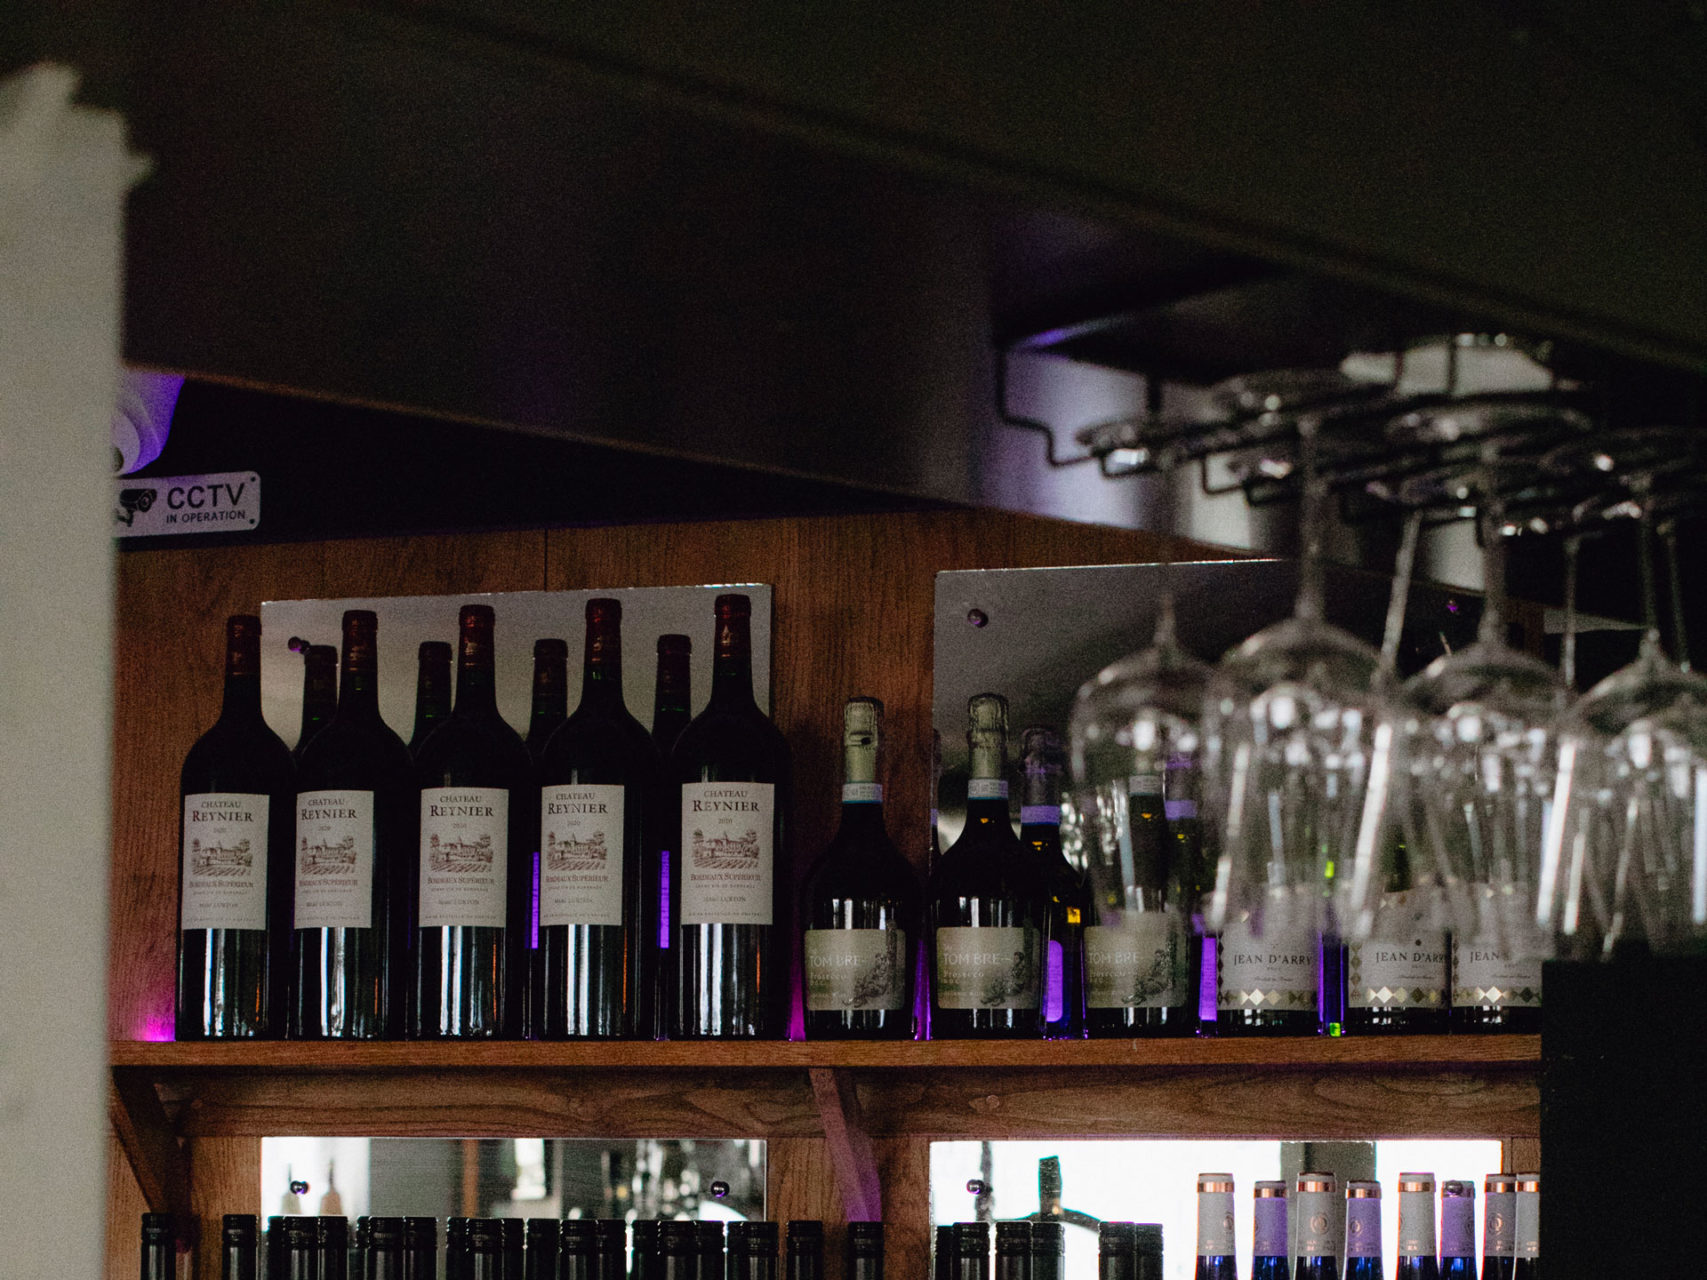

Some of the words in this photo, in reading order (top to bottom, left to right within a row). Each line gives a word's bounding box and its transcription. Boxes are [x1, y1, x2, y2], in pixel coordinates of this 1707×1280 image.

[167, 483, 246, 510] CCTV
[166, 514, 177, 523] IN
[181, 510, 246, 522] OPERATION
[703, 790, 748, 798] CHATEAU
[308, 799, 345, 807] CHATEAU
[548, 803, 609, 814] REYNIER
[692, 800, 760, 812] REYNIER
[192, 810, 254, 822] REYNIER
[301, 809, 357, 820] REYNIER
[430, 805, 494, 816] REYNIER
[809, 955, 832, 967] TOM
[943, 953, 970, 965] TOM
[973, 952, 1001, 965] BRE
[1088, 952, 1111, 964] TOM
[1234, 955, 1263, 966] JEAN
[1269, 955, 1312, 966] D'ARRY
[1376, 952, 1408, 963] JEAN
[1470, 951, 1499, 963] JEAN
